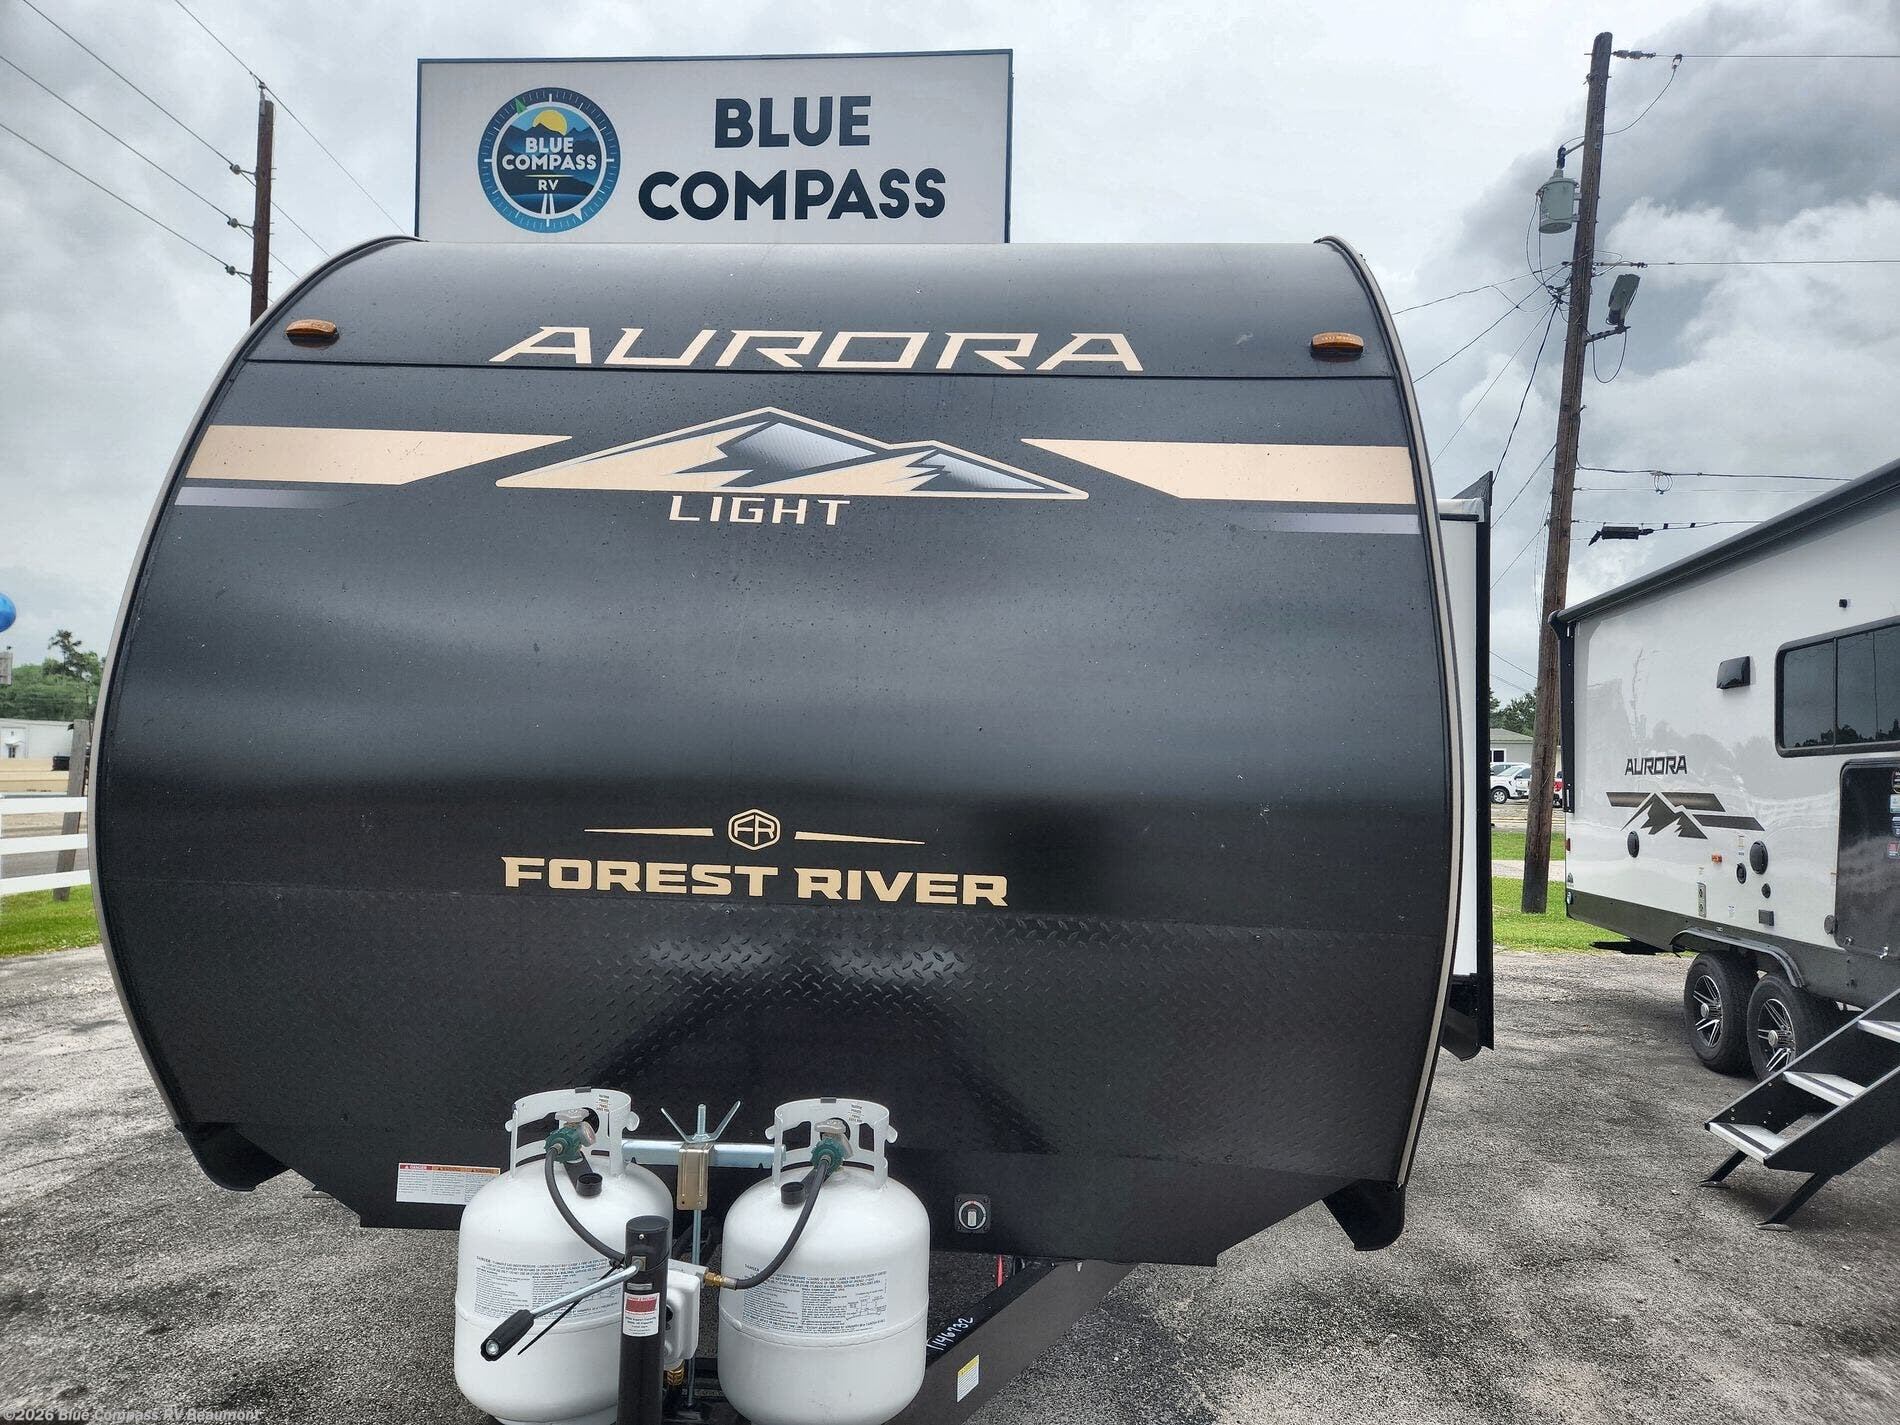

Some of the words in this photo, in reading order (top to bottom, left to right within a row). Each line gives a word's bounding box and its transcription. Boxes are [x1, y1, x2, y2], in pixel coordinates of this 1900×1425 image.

[715, 95, 872, 149] BLUE
[525, 137, 574, 154] BLUE
[501, 154, 598, 171] COMPASS
[537, 179, 560, 191] RV
[638, 167, 946, 221] COMPASS
[489, 326, 1144, 371] AURORA
[669, 495, 851, 526] LIGHT
[1624, 755, 1688, 776] AURORA
[501, 856, 779, 898] FOREST
[793, 867, 1009, 907] RIVER
